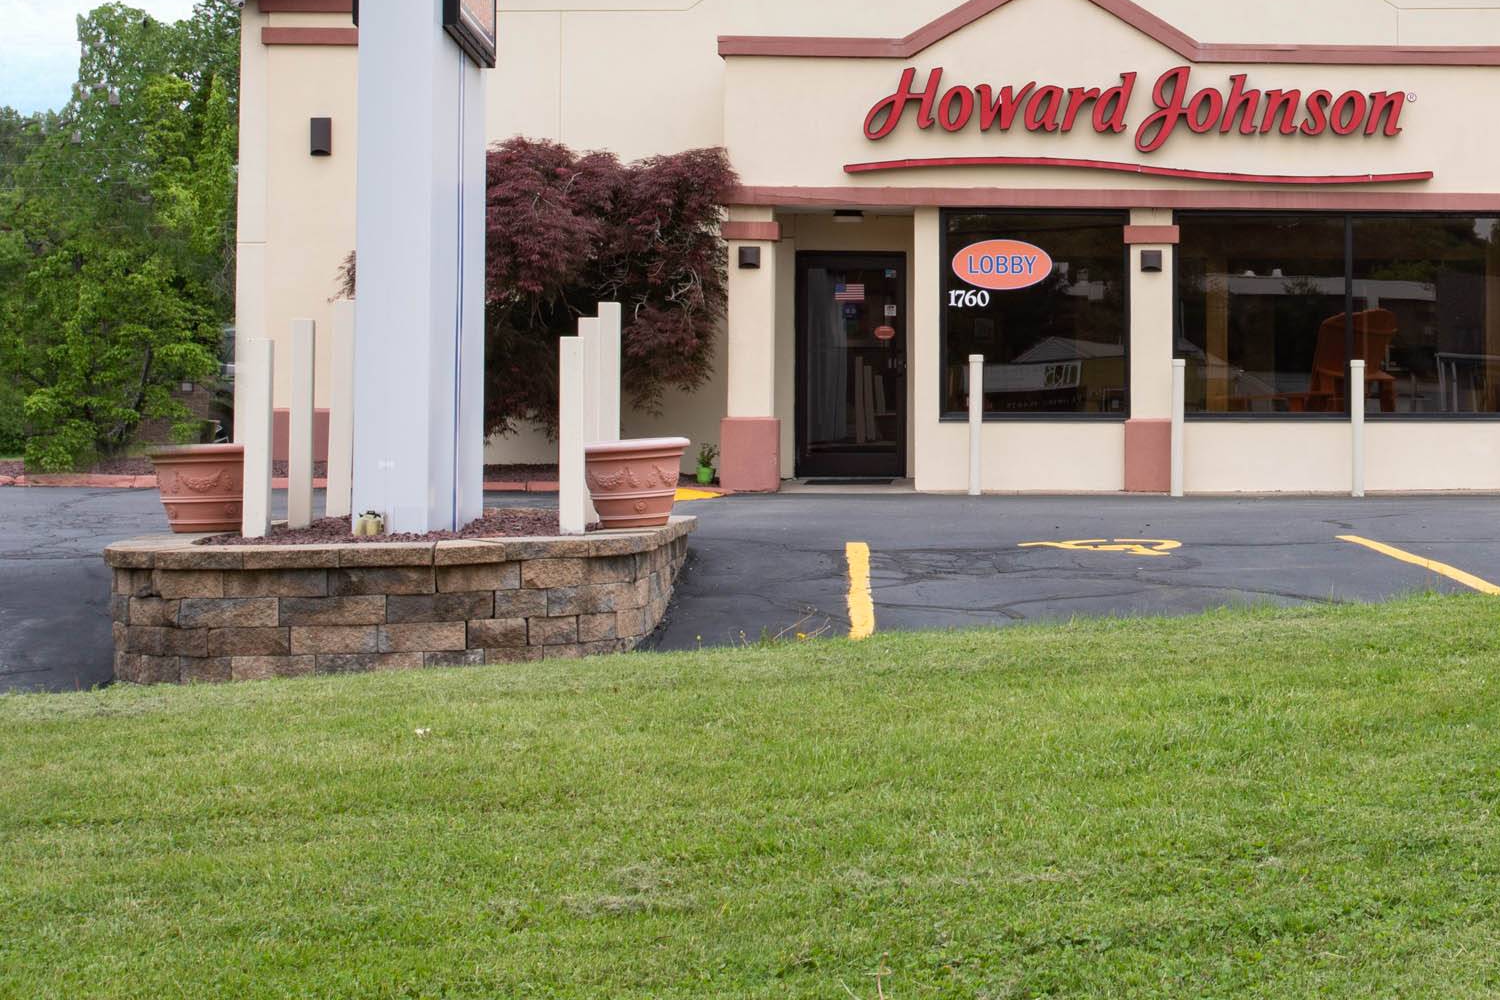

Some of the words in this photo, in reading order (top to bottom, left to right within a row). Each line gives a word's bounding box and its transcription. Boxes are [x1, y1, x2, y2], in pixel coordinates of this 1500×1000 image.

[863, 66, 1137, 141] Howard
[1134, 65, 1406, 153] Johnson
[968, 254, 1037, 275] LOBBY
[948, 289, 990, 308] 1760
